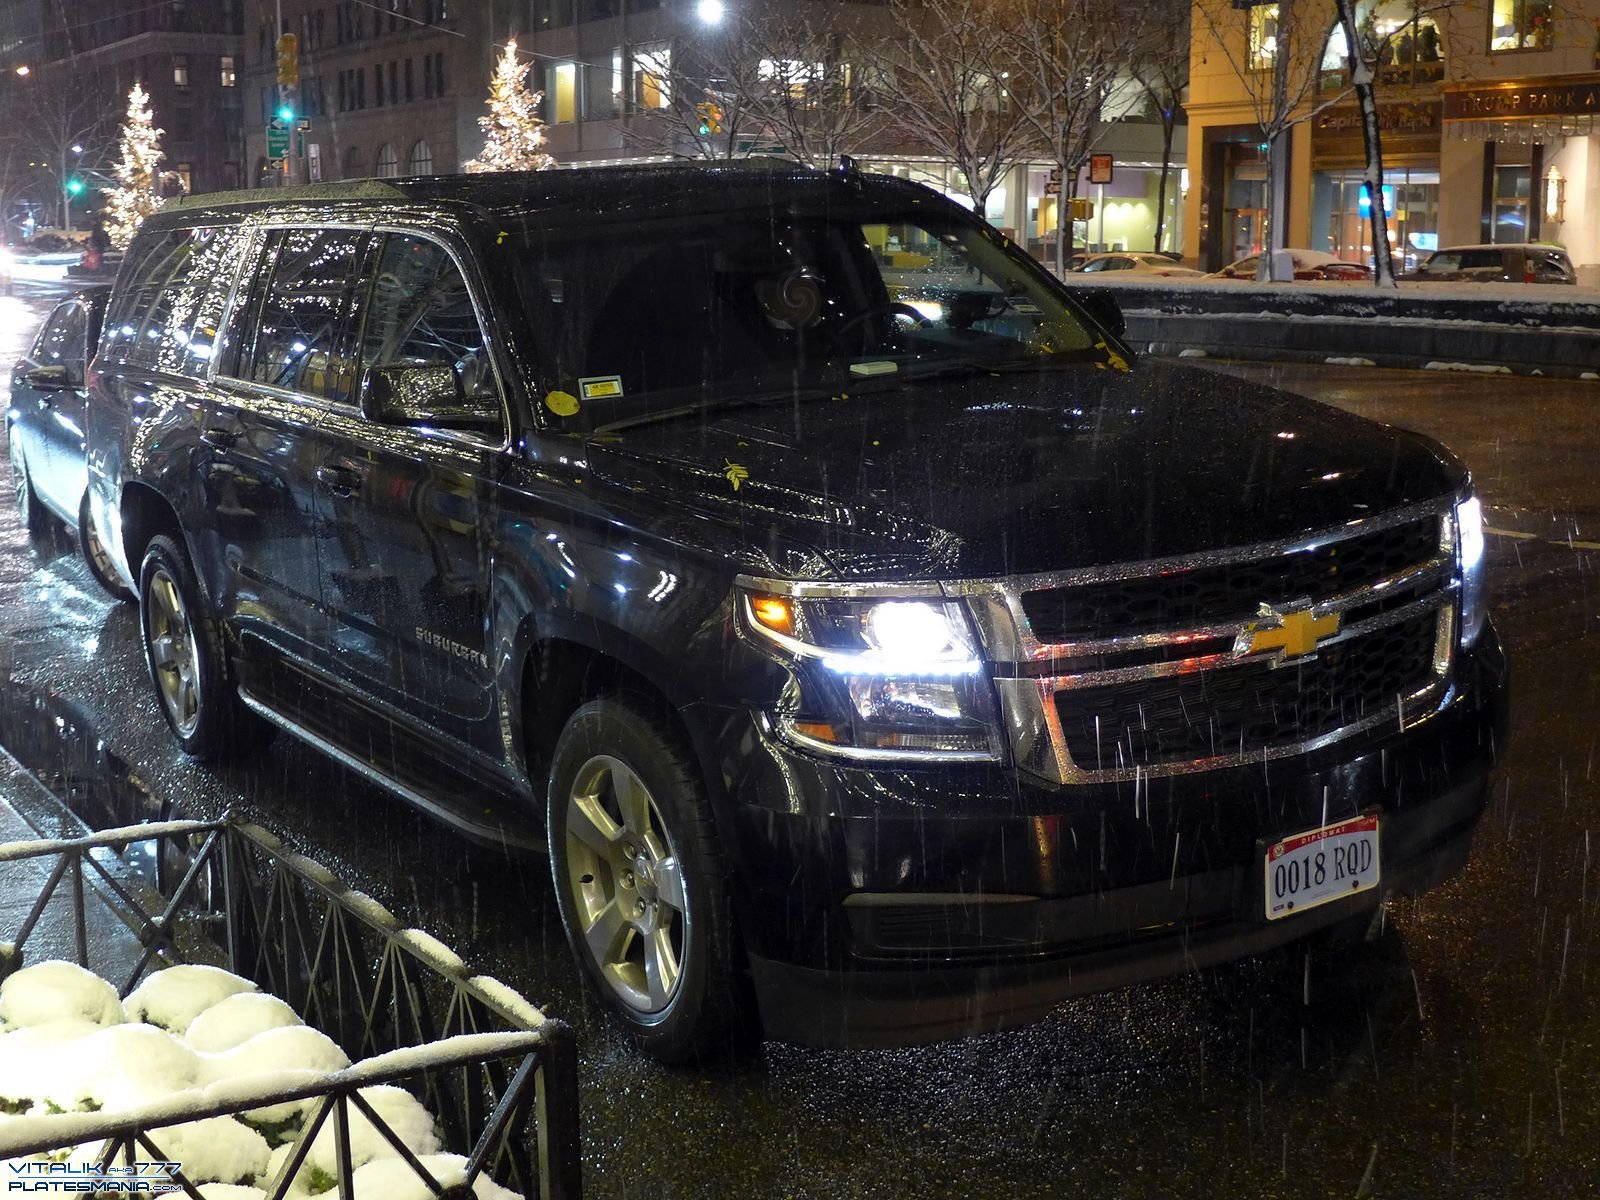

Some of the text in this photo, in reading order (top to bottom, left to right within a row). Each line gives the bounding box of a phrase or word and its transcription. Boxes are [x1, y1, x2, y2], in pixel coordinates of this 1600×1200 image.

[1461, 94, 1521, 112] TRUMP
[1529, 92, 1576, 109] PARK
[1319, 113, 1363, 130] Capita
[415, 626, 489, 669] SUBURBAN
[1301, 826, 1346, 844] DIPLOMAT
[1274, 839, 1372, 898] 0018 RQD
